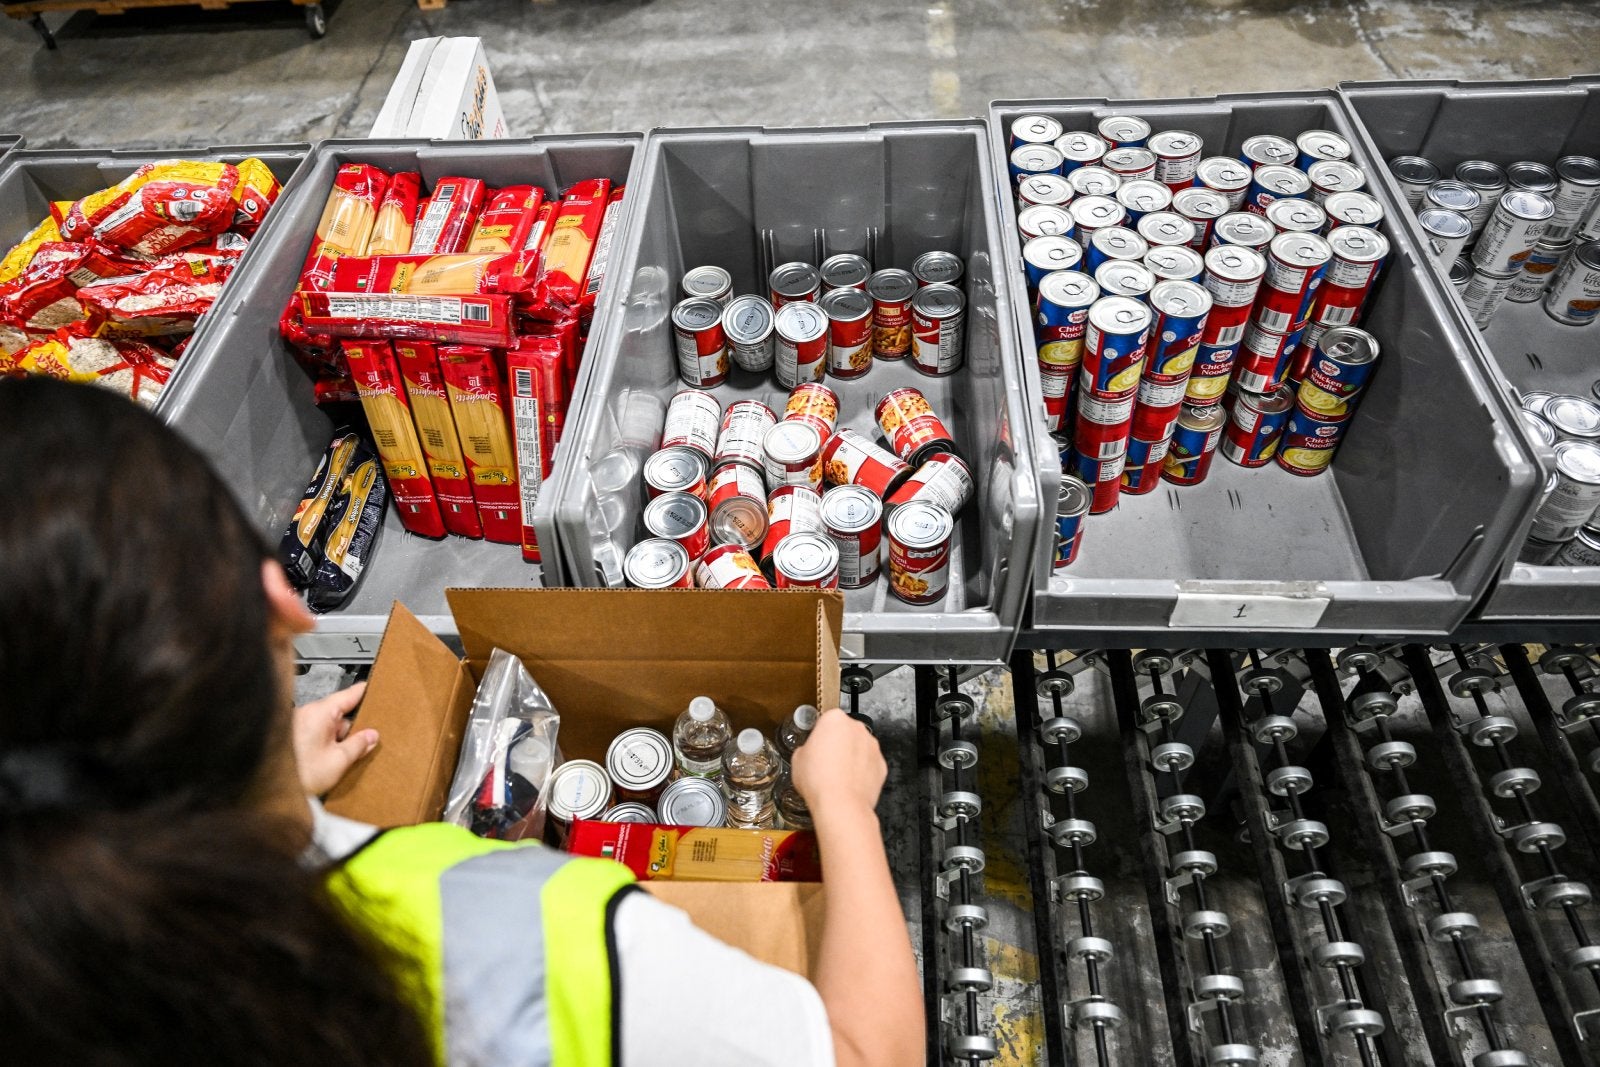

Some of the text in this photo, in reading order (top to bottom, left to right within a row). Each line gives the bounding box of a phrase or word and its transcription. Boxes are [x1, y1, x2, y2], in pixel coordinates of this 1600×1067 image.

[142, 228, 165, 242] OATS
[148, 234, 177, 255] QUICK
[162, 292, 198, 307] QUICK
[1200, 360, 1233, 370] Chicken
[1201, 367, 1230, 376] Noodle
[1310, 374, 1338, 393] Noodle
[1311, 367, 1343, 388] Chicken
[359, 382, 397, 399] Spaghetti
[410, 382, 446, 400] Spaghetti
[455, 386, 498, 403] Spaghetti
[1232, 603, 1247, 618] 1
[352, 636, 371, 653] 1
